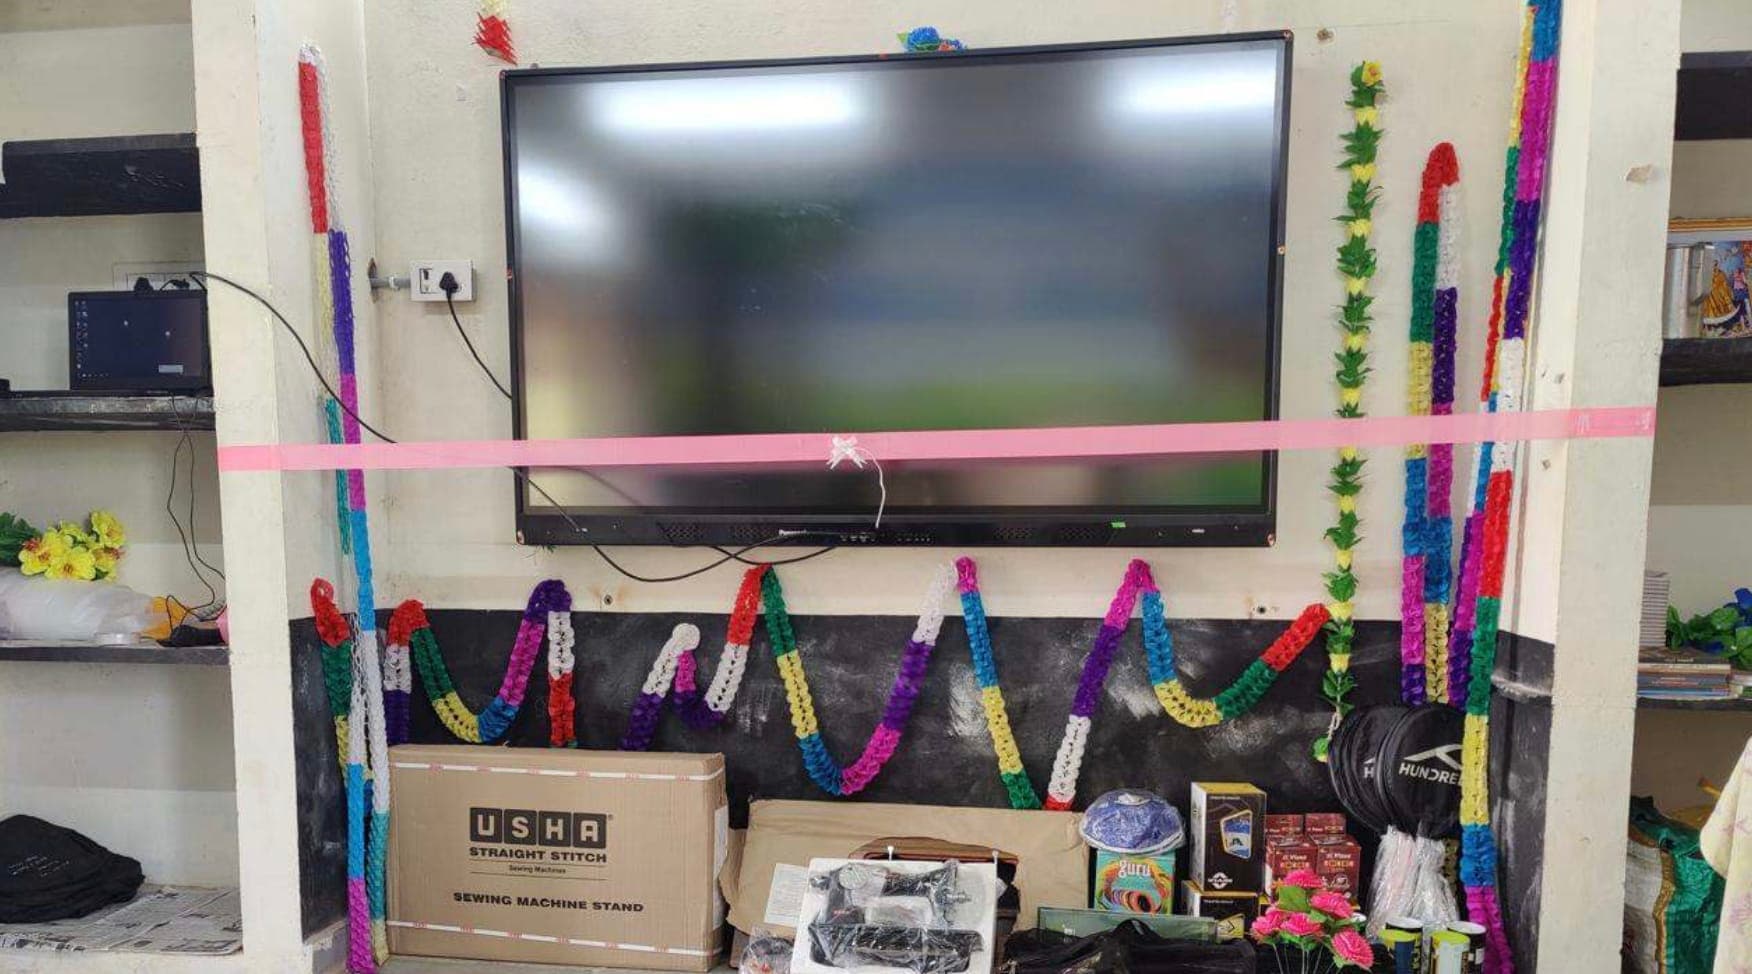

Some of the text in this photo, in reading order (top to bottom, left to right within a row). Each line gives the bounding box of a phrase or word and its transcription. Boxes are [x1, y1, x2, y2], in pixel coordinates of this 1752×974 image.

[1399, 762, 1463, 786] HUNDRE
[476, 813, 600, 843] USHA
[469, 846, 607, 863] STRAIGHT STITCH
[509, 864, 566, 874] Sewing Machines
[1118, 860, 1151, 878] guru
[453, 892, 644, 912] SEWING MACHINE STAND
